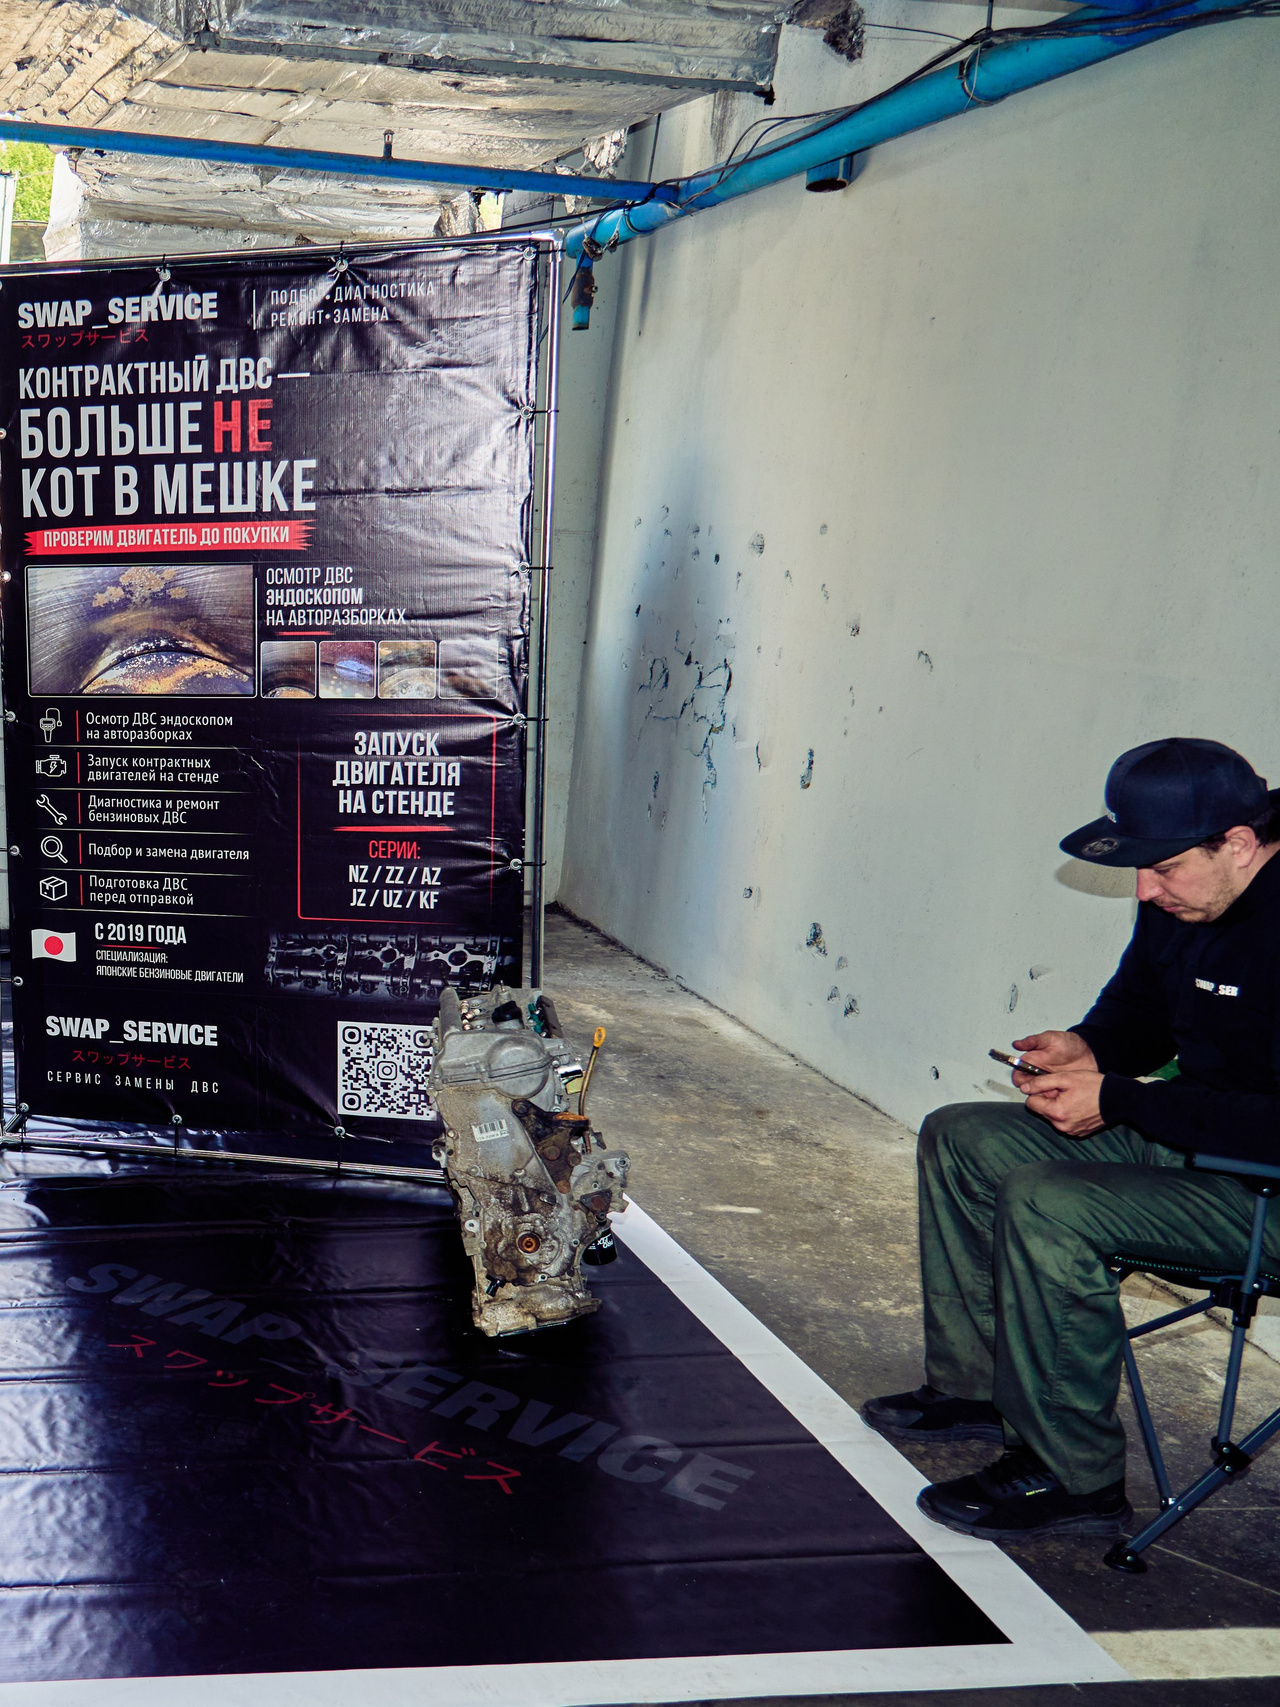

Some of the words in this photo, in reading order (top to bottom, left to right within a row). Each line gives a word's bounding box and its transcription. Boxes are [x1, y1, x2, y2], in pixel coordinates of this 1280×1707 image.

[271, 288, 324, 305] ПОДБО
[333, 281, 435, 303] ДИАГНОСТИКА
[18, 292, 218, 329] SWAP_SERVICE
[271, 309, 324, 327] РЕМОНТ
[333, 306, 389, 324] ЗАМЕНА
[21, 328, 149, 348] スワップサービス
[19, 354, 209, 399] КОНТРАКТНЫЙ
[216, 357, 272, 394] ДВС
[20, 402, 203, 459] БОЛЬШЕ
[214, 399, 273, 453] НЕ
[22, 466, 100, 518] КОТ
[114, 465, 140, 515] В
[153, 459, 317, 515] МЕШКЕ
[43, 530, 114, 547] ПРОВЕРИМ
[116, 527, 197, 548] ДВИГАТЕЛЬ
[200, 527, 220, 546] ДО
[223, 526, 289, 544] ПОКУПКИ
[266, 567, 321, 585] ОСМОТР
[324, 566, 353, 586] ДВС
[266, 587, 363, 607] ЭНДОСКОПОМ
[266, 609, 285, 626] НА
[288, 608, 407, 626] АВТОРАЗБОРКАХ
[86, 711, 130, 728] Осмотр
[132, 712, 157, 726] ДВС
[160, 714, 233, 727] эндоскопом
[86, 730, 100, 740] на
[103, 728, 193, 743] авторазборках
[354, 731, 440, 757] ЗАПУСК
[87, 753, 129, 770] Запуск
[132, 756, 211, 770] контрактных
[87, 769, 156, 783] двигателей
[159, 772, 174, 782] на
[177, 772, 220, 784] стенде
[332, 760, 461, 787] ДВИГАТЕЛЯ
[88, 794, 162, 809] Диагностика
[165, 799, 173, 809] и
[176, 798, 220, 811] ремонт
[338, 789, 367, 814] НА
[371, 790, 455, 818] СТЕНДЕ
[88, 809, 160, 823] бензиновых
[162, 811, 187, 825] ДВС
[88, 842, 132, 859] Подбор
[135, 847, 143, 857] и
[146, 847, 187, 859] замена
[190, 848, 250, 861] двигателя
[368, 840, 421, 860] СЕРИИ:
[89, 875, 160, 890] Подготовка
[162, 878, 188, 892] ДВС
[348, 864, 369, 884] NZ
[385, 865, 404, 885] ZZ
[421, 867, 442, 886] AZ
[89, 891, 127, 905] перед
[129, 892, 194, 907] отправкой
[350, 888, 367, 907] JZ
[383, 889, 403, 908] UZ
[419, 891, 439, 909] KF
[94, 922, 104, 941] С
[107, 923, 144, 943] 2019
[147, 924, 187, 946] ГОДА
[95, 949, 169, 964] СПЕЦИАЛИЗАЦИЯ:
[96, 965, 138, 978] ЯПОНСКИЕ
[139, 967, 192, 981] БЕНЗИНОВЫЕ
[194, 970, 244, 984] ДВИГАТЕЛИ
[45, 1015, 218, 1047] SWAP_SERVICE
[72, 1050, 192, 1070] スワップサービス
[47, 1070, 102, 1085] СЕРВИС
[115, 1074, 174, 1090] ЗАМЕНЫ
[190, 1080, 219, 1094] ДВС
